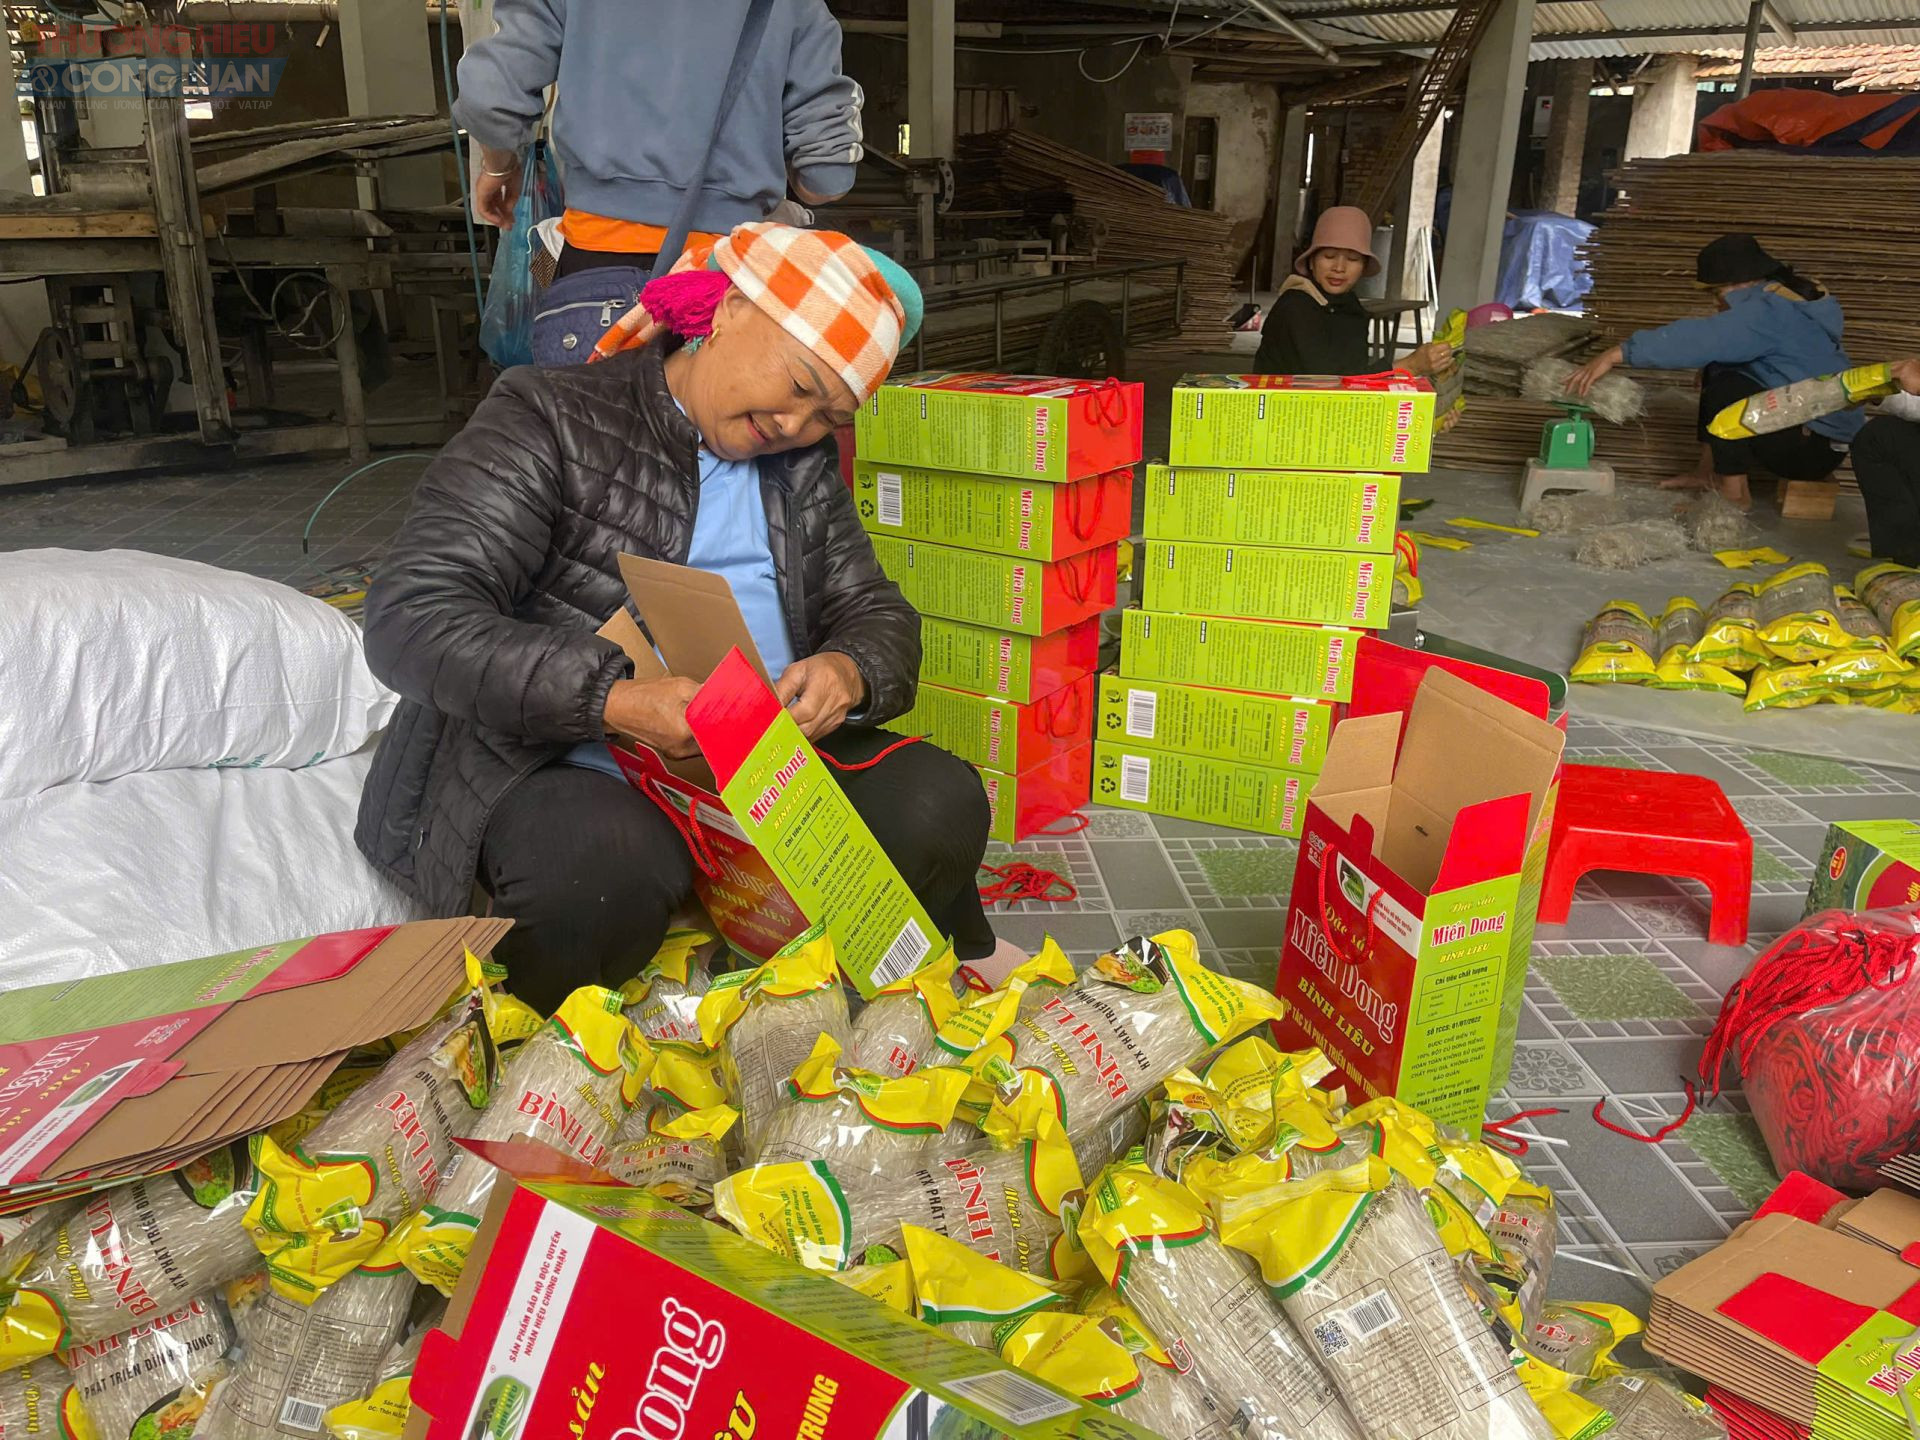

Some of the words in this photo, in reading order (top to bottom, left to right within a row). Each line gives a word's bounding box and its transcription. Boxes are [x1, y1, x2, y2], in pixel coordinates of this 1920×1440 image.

[1036, 407, 1048, 437] Miến
[1397, 401, 1413, 430] Miến
[1034, 440, 1047, 472] Dong
[1392, 432, 1410, 464] Dong
[1021, 489, 1033, 516] Miến
[1363, 484, 1378, 511] Miến
[1019, 520, 1032, 550] Dong
[1357, 514, 1375, 544] Dong
[1012, 565, 1025, 594] Miến
[1357, 562, 1373, 588] Miến
[1011, 596, 1024, 625] Dong
[1352, 590, 1369, 620] Dong
[1000, 637, 1012, 662] Miến
[1328, 636, 1344, 663] Miến
[998, 664, 1010, 693] Dong
[1323, 665, 1341, 694] Dong
[990, 708, 1001, 733] Miến
[1294, 709, 1308, 734] Miến
[989, 735, 1000, 763] Dong
[1289, 736, 1305, 765] Dong
[748, 785, 782, 828] Miến
[774, 745, 809, 787] Dong
[1284, 779, 1298, 804] Miến
[1280, 805, 1296, 833] Dong
[878, 878, 895, 896] TRUNG
[1431, 921, 1466, 947] Miến
[1470, 911, 1506, 936] Dong
[1439, 949, 1464, 963] BÌNH
[1466, 943, 1490, 956] LIÊU
[1290, 908, 1338, 984] Miến
[1341, 962, 1398, 1044] Dong
[1435, 976, 1446, 986] Chỉ
[1459, 970, 1472, 981] chất
[1297, 975, 1335, 1019] BÌNH
[1337, 1015, 1375, 1057] LIÊU
[1113, 1024, 1136, 1050] PHÁT
[1292, 1004, 1303, 1028] TÁC
[1301, 1012, 1312, 1036] XÃ
[1311, 1024, 1328, 1054] PHÁT
[1328, 1036, 1348, 1070] TRIỂN
[1346, 1058, 1364, 1086] ĐÌNH
[1071, 1022, 1130, 1100] BÌNH
[1131, 1049, 1151, 1070] HTX
[414, 1067, 441, 1101] TRUNG
[1416, 1097, 1430, 1108] PHÁT
[1431, 1091, 1447, 1104] TRIỂN
[1448, 1088, 1462, 1099] ĐÌNH
[1463, 1085, 1480, 1096] TRUNG
[372, 1085, 433, 1165] LIÊU
[517, 1090, 583, 1146] BÌNH
[915, 1168, 933, 1187] HTX
[801, 1190, 813, 1210] Không
[808, 1210, 817, 1224] chất
[923, 1187, 946, 1221] PHÁT
[944, 1151, 1004, 1244] BÌNH
[997, 1179, 1027, 1231] Miến
[134, 1209, 163, 1247] TRIỂN
[1494, 1230, 1529, 1246] TRUNG
[542, 1229, 563, 1260] QUYỀN
[152, 1245, 176, 1275] PHÁT
[536, 1260, 551, 1280] ĐỘC
[551, 1248, 569, 1274] NHẬN
[1325, 1263, 1340, 1280] minh
[62, 1260, 92, 1305] Miến
[531, 1280, 544, 1294] HỘ
[539, 1275, 560, 1306] CHỨNG
[524, 1294, 539, 1313] BẢO
[532, 1306, 548, 1328] HIỆU
[513, 1314, 533, 1341] PHẨM
[509, 1338, 521, 1363] SẢN
[1866, 1363, 1913, 1398] Miến
[570, 1361, 605, 1436] sản
